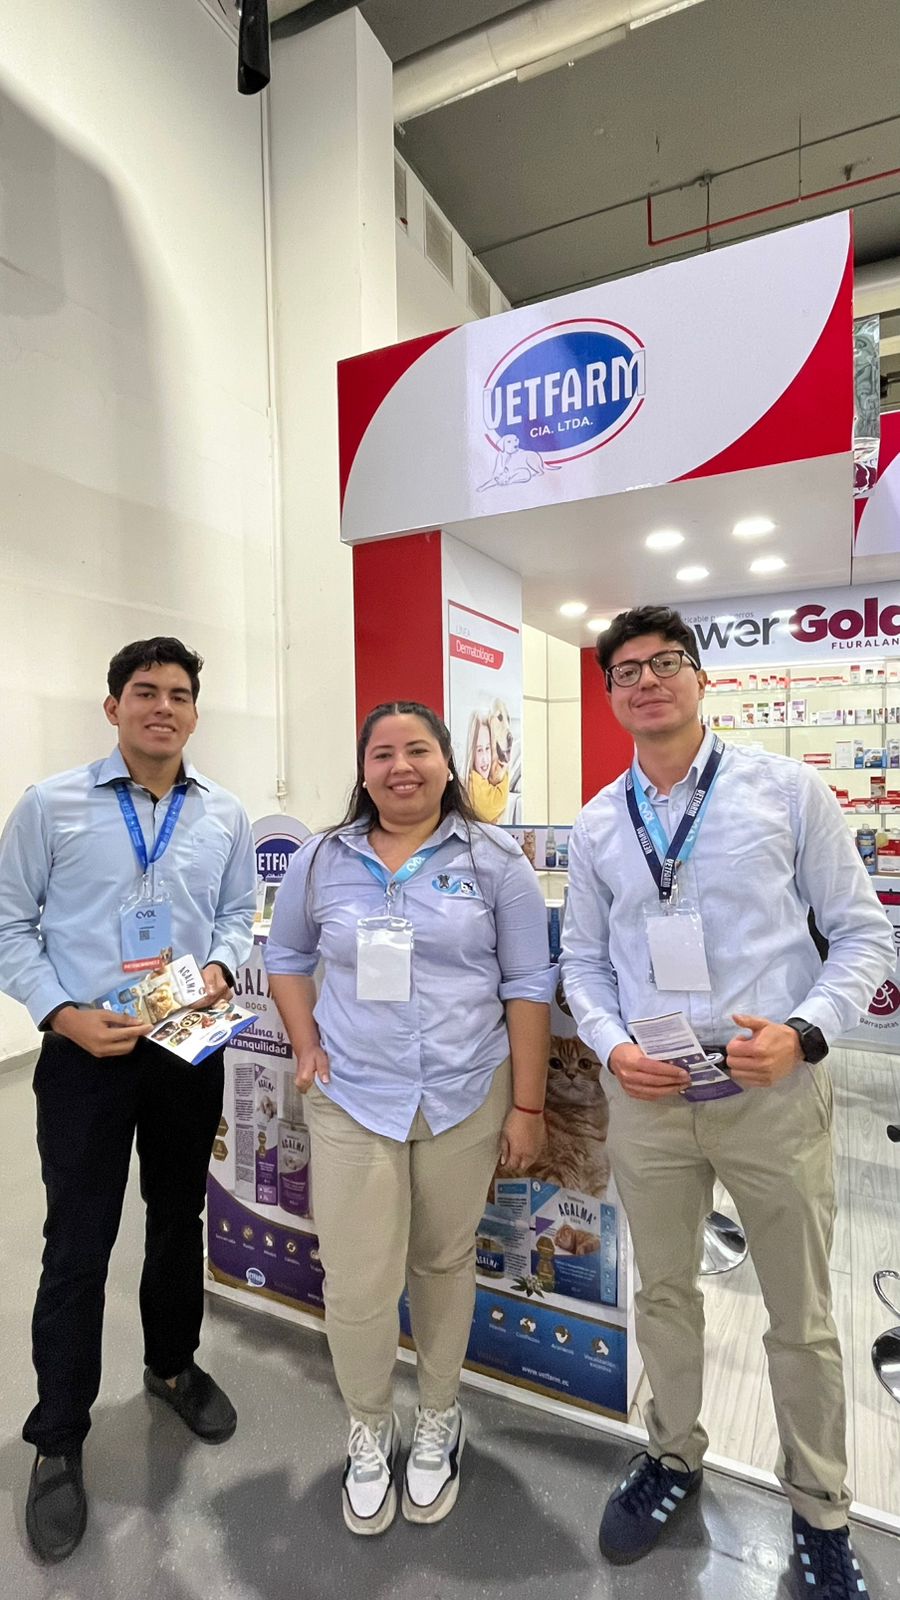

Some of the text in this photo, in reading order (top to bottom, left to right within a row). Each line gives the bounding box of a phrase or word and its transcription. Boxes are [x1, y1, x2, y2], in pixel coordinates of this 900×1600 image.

[483, 349, 646, 430] VETFARM
[530, 416, 594, 438] CIA. LTDA.
[684, 614, 709, 624] ticable
[693, 617, 780, 650] wer
[686, 789, 706, 817] VETFARM
[637, 826, 653, 855] VETFARM
[257, 852, 296, 872] ETFA
[662, 858, 675, 888] VETFARM
[245, 1001, 268, 1012] DOGS
[240, 1023, 274, 1039] alma
[277, 1031, 287, 1045] y
[229, 1038, 287, 1055] tranquilidad
